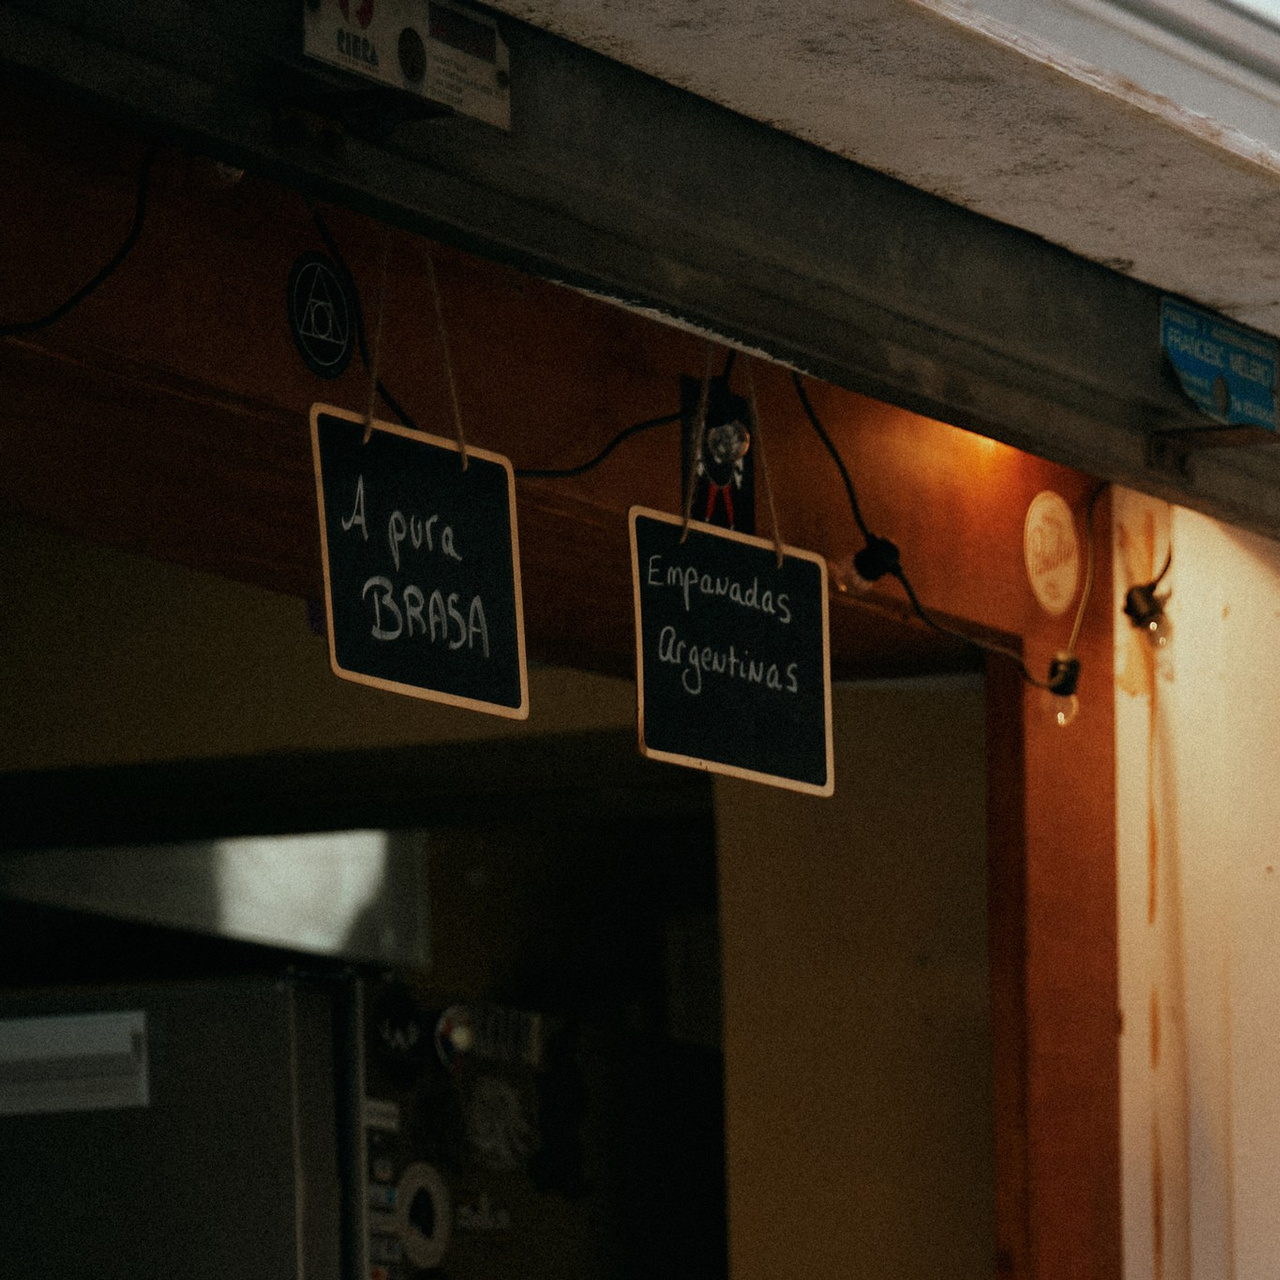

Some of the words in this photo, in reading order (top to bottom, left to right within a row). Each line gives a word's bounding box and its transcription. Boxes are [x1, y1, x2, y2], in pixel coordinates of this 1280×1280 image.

[340, 474, 369, 541] A
[387, 508, 463, 572] pura
[362, 574, 490, 659] BRASA
[646, 554, 794, 624] Empanadas
[657, 625, 799, 696] Argentinas
